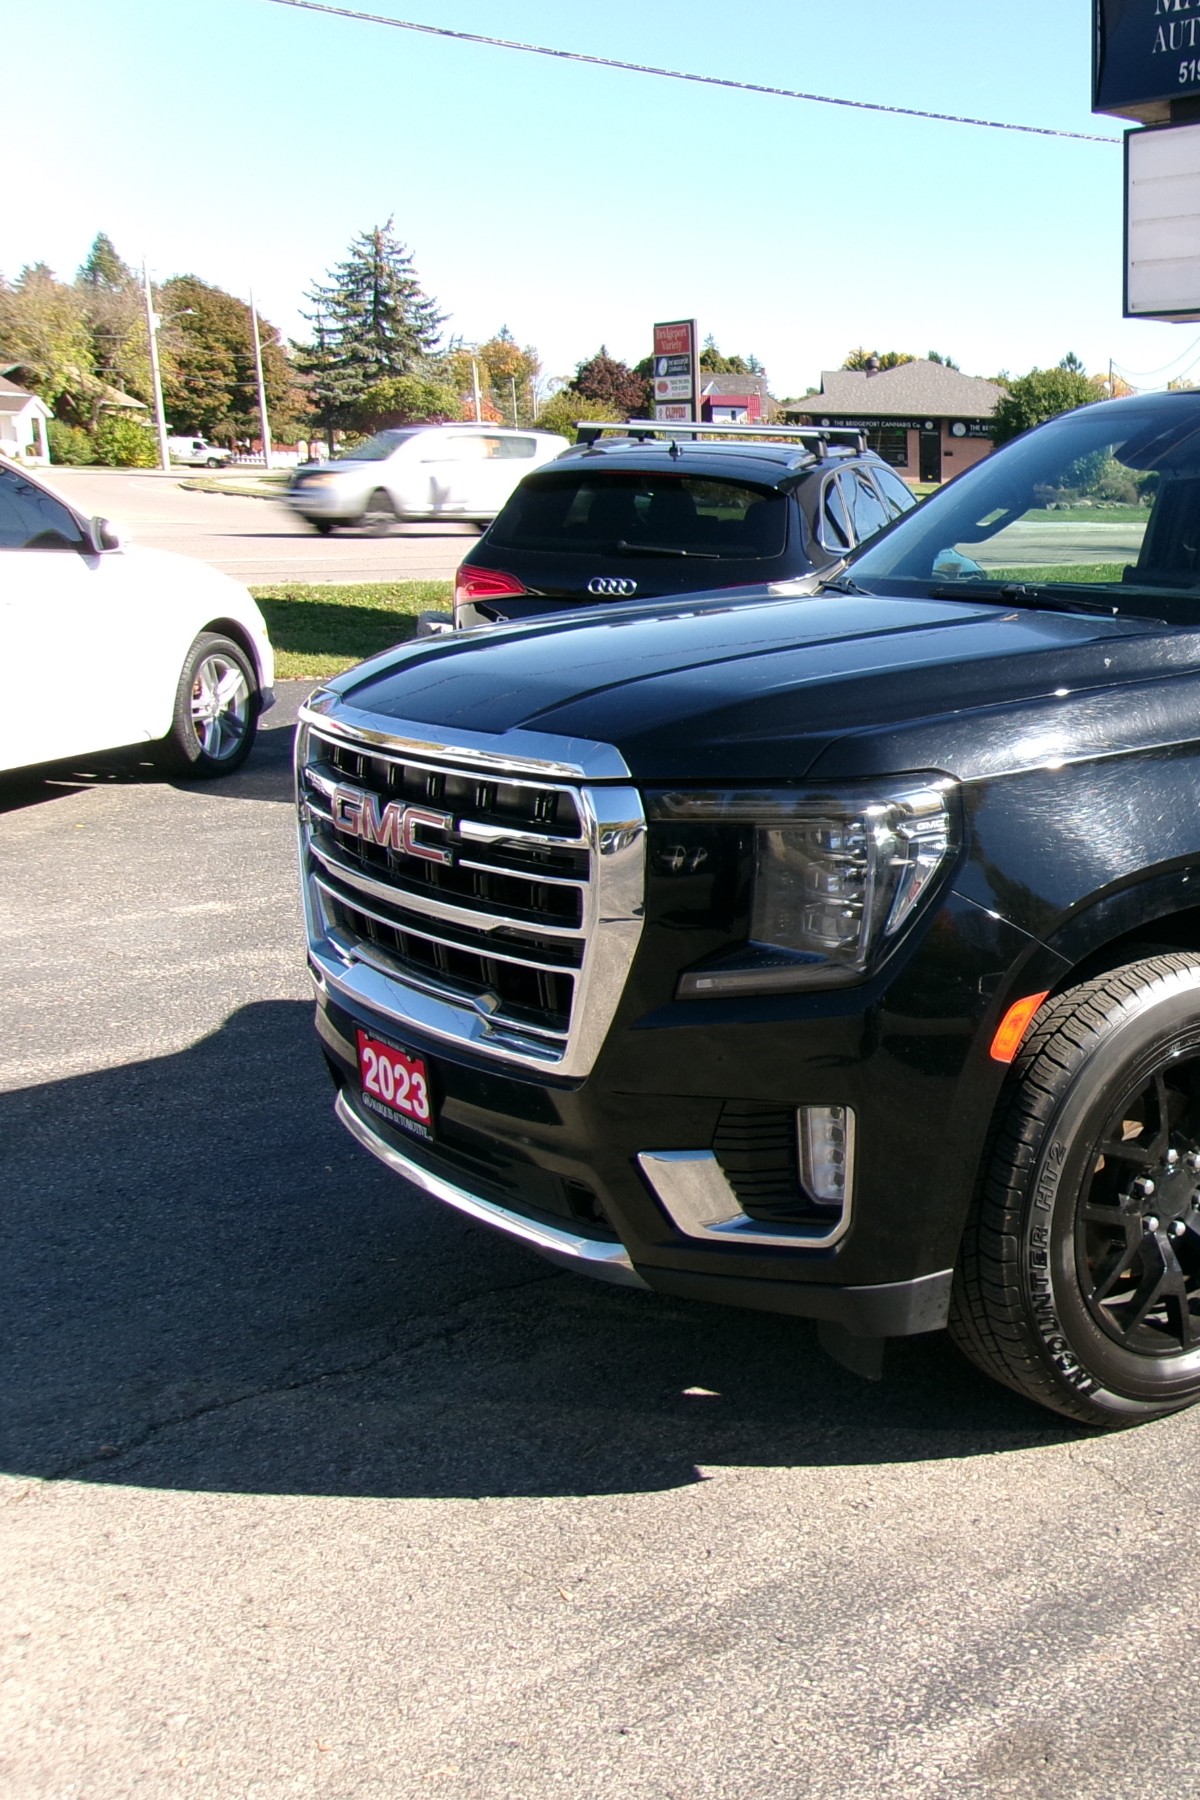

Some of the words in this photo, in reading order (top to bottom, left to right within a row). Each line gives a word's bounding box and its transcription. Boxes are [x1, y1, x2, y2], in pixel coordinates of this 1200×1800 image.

[656, 327, 686, 340] Bridgeport
[661, 340, 682, 351] Variety
[331, 782, 454, 867] GMC
[916, 819, 945, 831] GMC
[363, 1047, 430, 1119] 2023
[1035, 1140, 1067, 1212] HT2
